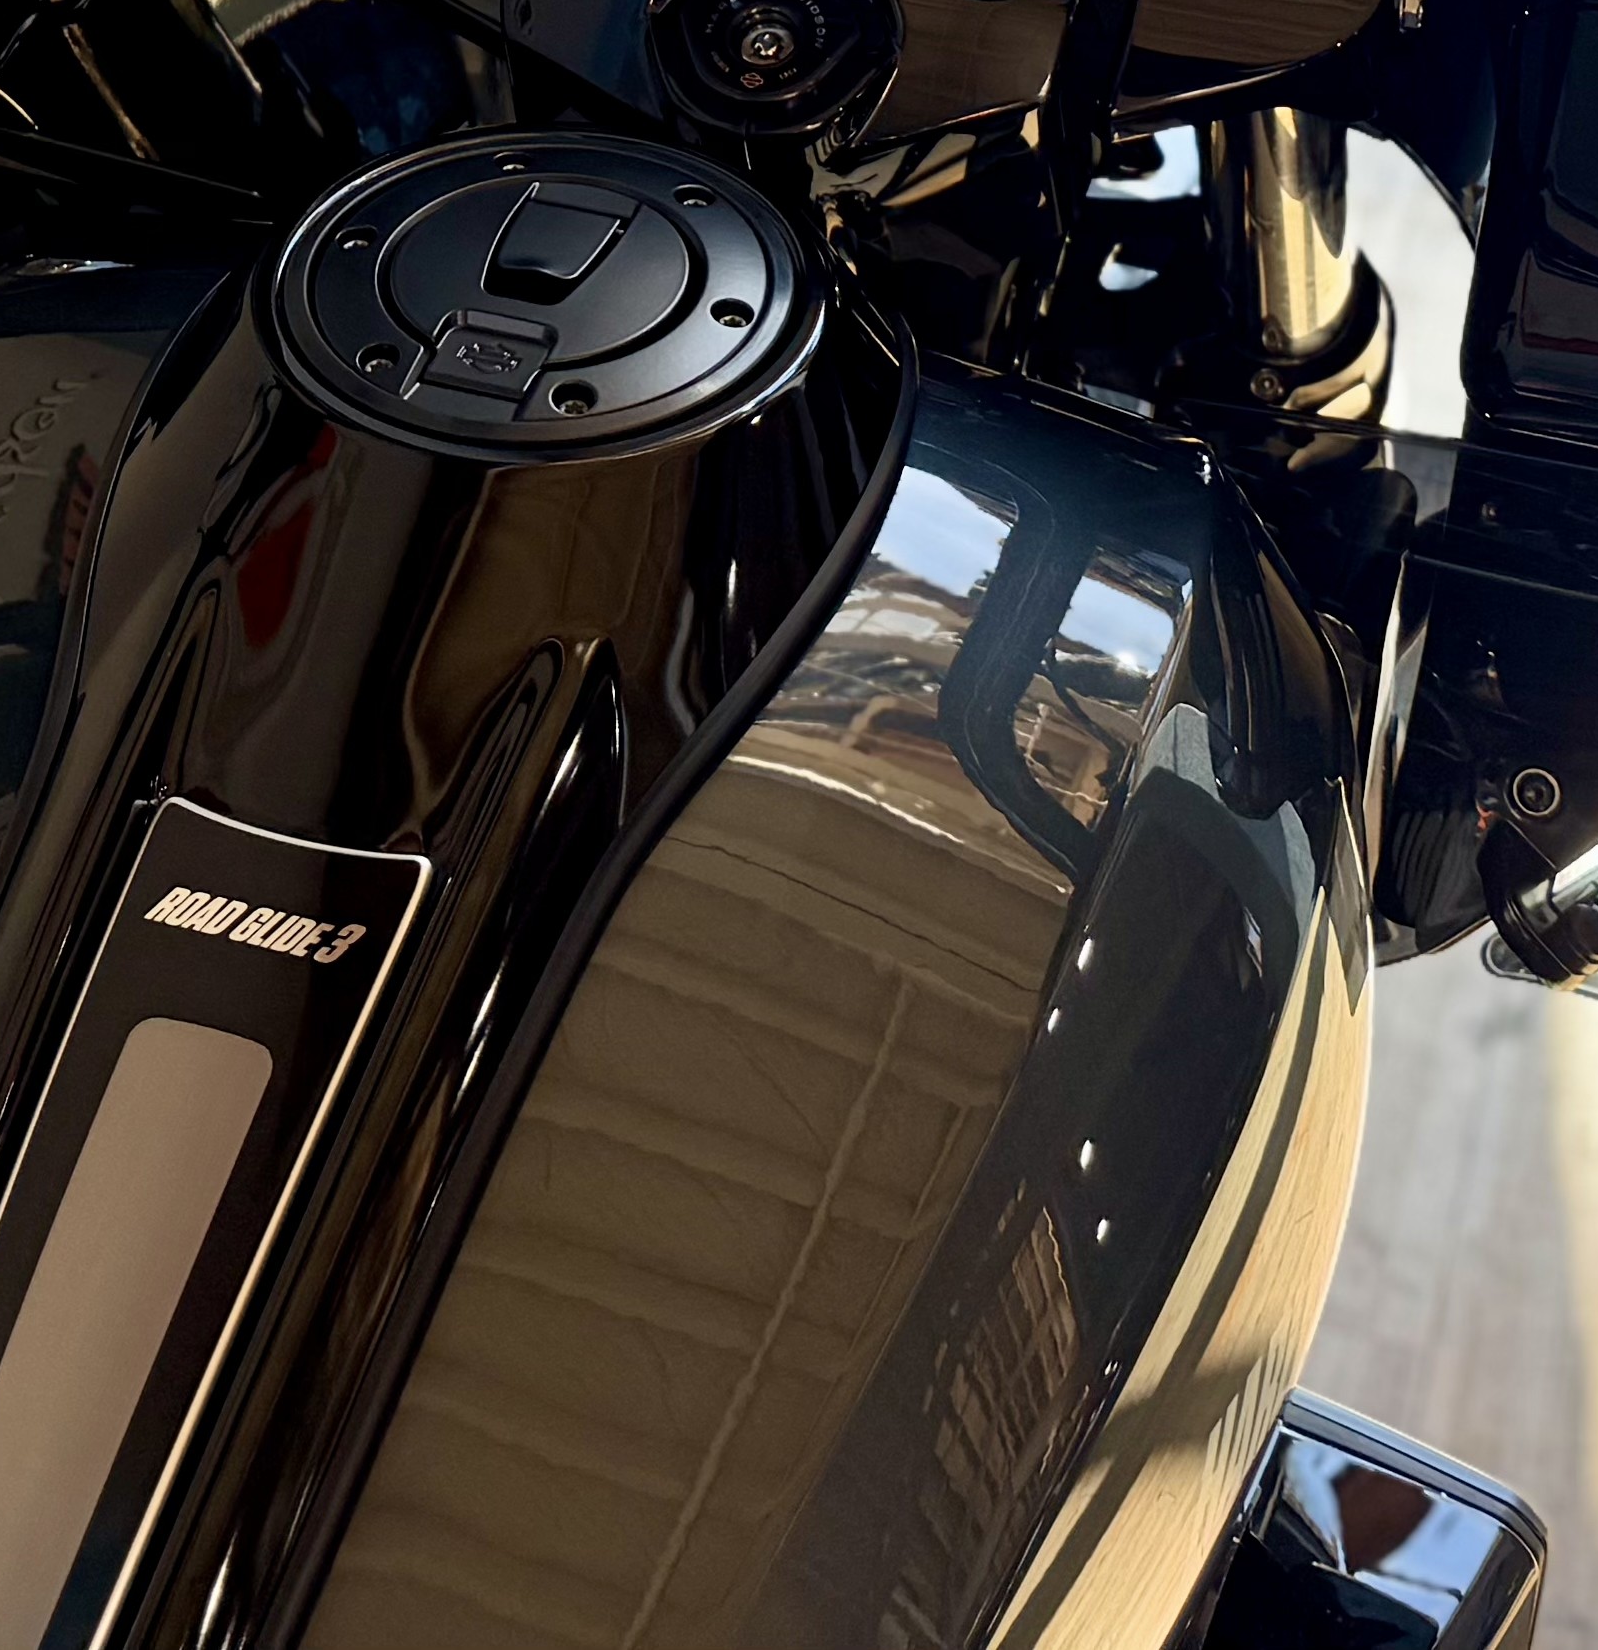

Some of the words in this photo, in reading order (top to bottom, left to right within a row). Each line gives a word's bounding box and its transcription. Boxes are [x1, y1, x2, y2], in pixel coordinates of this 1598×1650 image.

[143, 886, 249, 935] ROAD
[228, 907, 335, 957] GLIDE
[313, 923, 367, 964] 3
